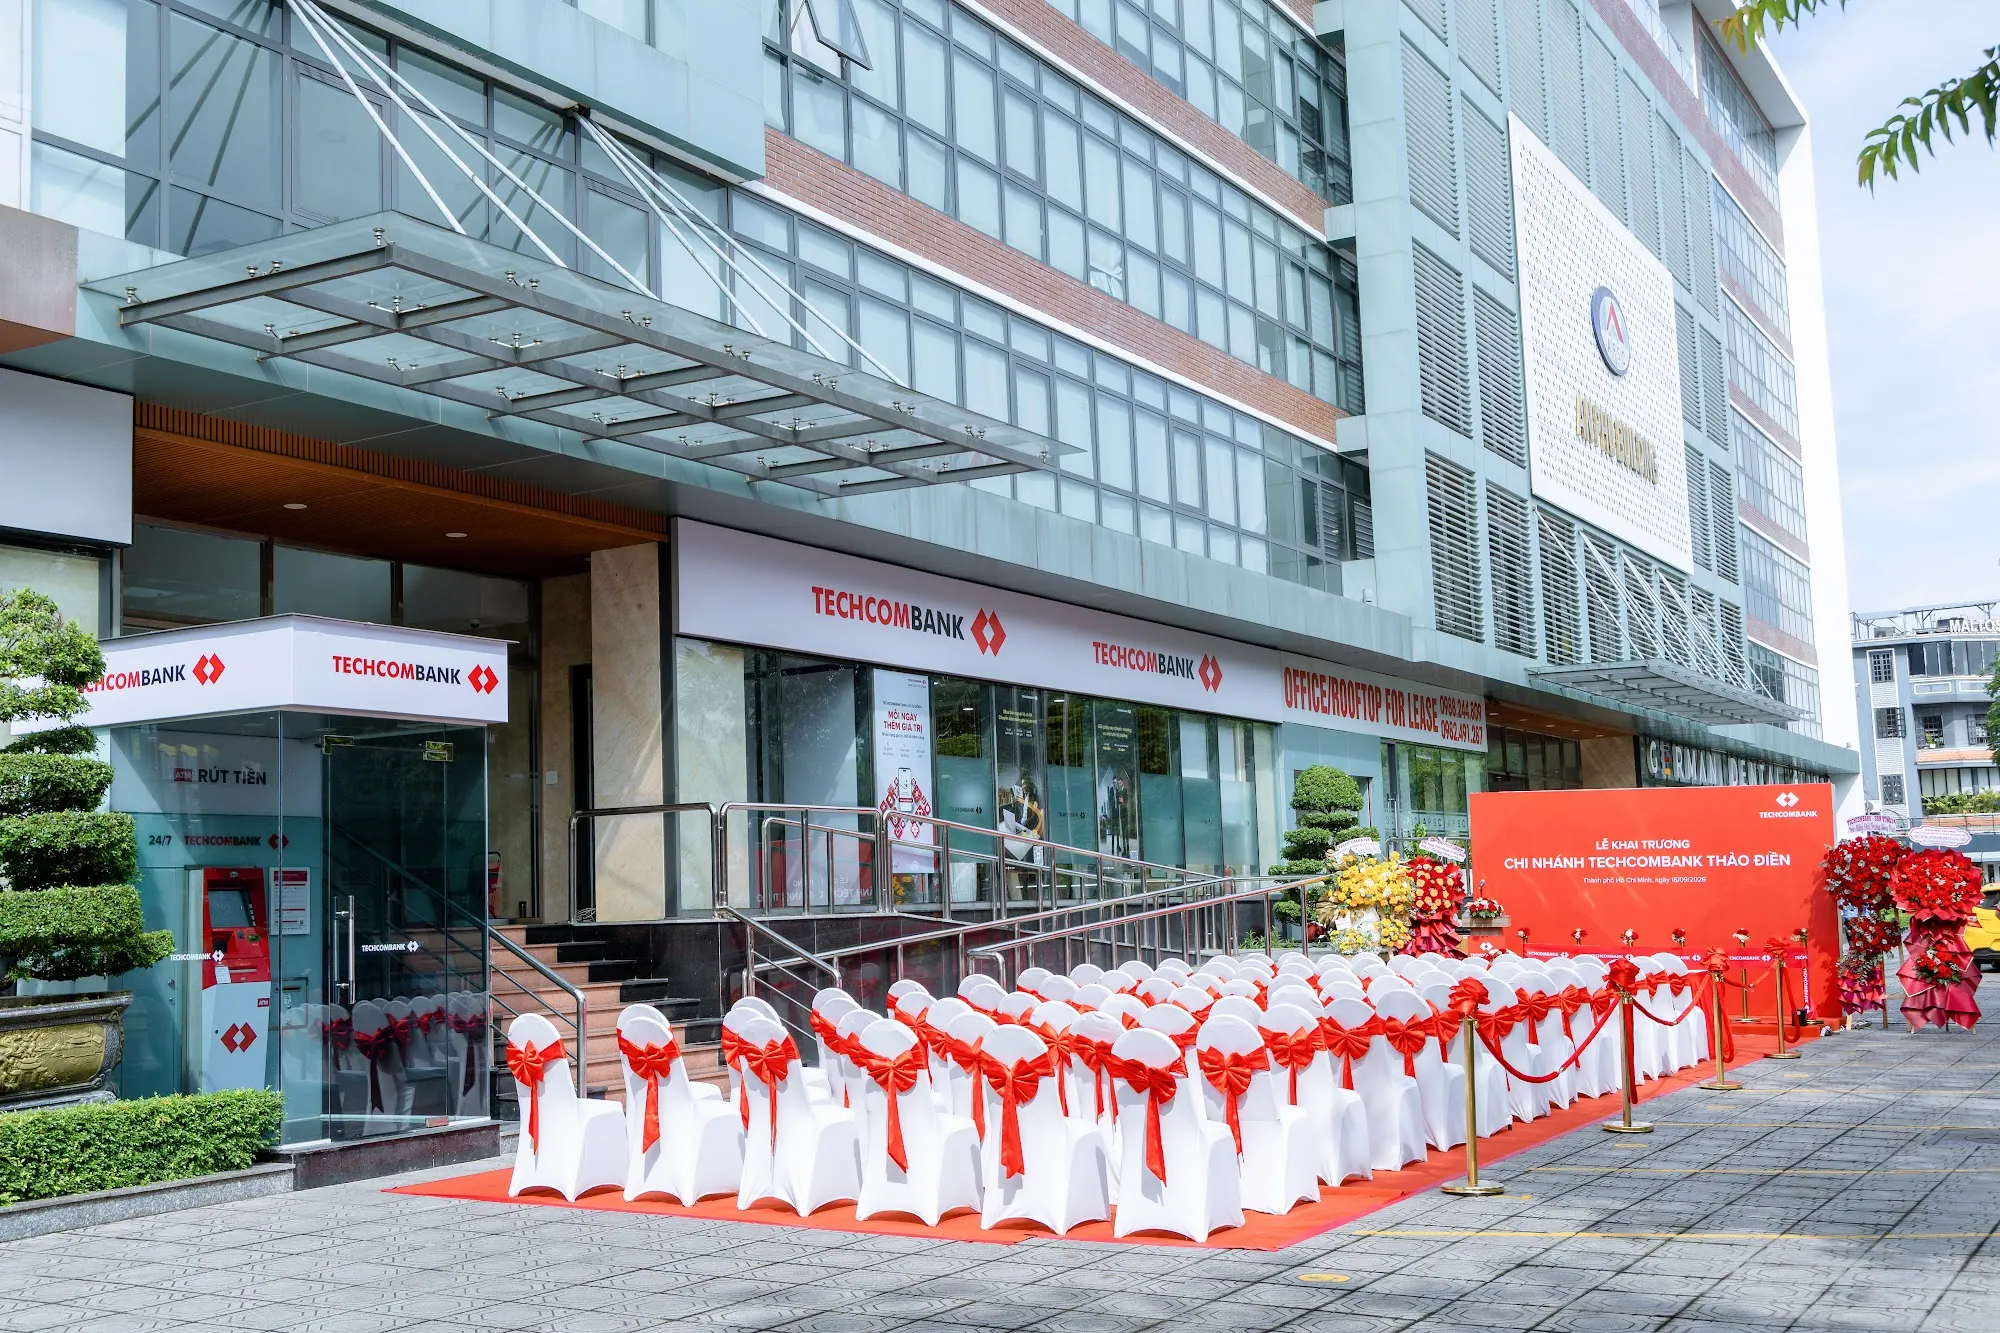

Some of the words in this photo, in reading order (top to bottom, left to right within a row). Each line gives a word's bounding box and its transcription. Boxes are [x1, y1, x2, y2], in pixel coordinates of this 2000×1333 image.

[811, 585, 965, 641] TECHCOMBANK
[332, 655, 461, 685] TECHCOMBANK
[1092, 641, 1195, 680] TECHCOMBANK
[77, 664, 186, 694] CHCOMBANK
[1283, 666, 1382, 723] OFFICE/ROOFTOP
[1384, 687, 1406, 728] FOR
[1408, 692, 1439, 733] LEASE
[1646, 740, 1718, 785] GERMAN
[175, 770, 192, 780] ATM
[198, 766, 229, 784] RÚT
[233, 766, 267, 785] TIỀN
[1758, 810, 1818, 819] TECHCOMBANK
[148, 834, 172, 847] 24/7
[184, 835, 262, 846] TECHCOMBANK
[1595, 837, 1609, 850] LỄ
[1611, 840, 1639, 850] KHAI
[1641, 839, 1690, 850] TRƯƠNG
[1504, 857, 1529, 870] CHI
[1532, 854, 1585, 869] NHÁNH
[1588, 855, 1703, 868] TECHCOMBANK
[1706, 851, 1750, 867] THẢO
[1753, 850, 1791, 867] ĐIỀN
[1602, 877, 1614, 885] phố
[1637, 876, 1654, 884] Minh,
[1654, 876, 1670, 885] ngày
[170, 952, 212, 961] TECHCOMBANK
[361, 943, 406, 952] TECHCOMBANK
